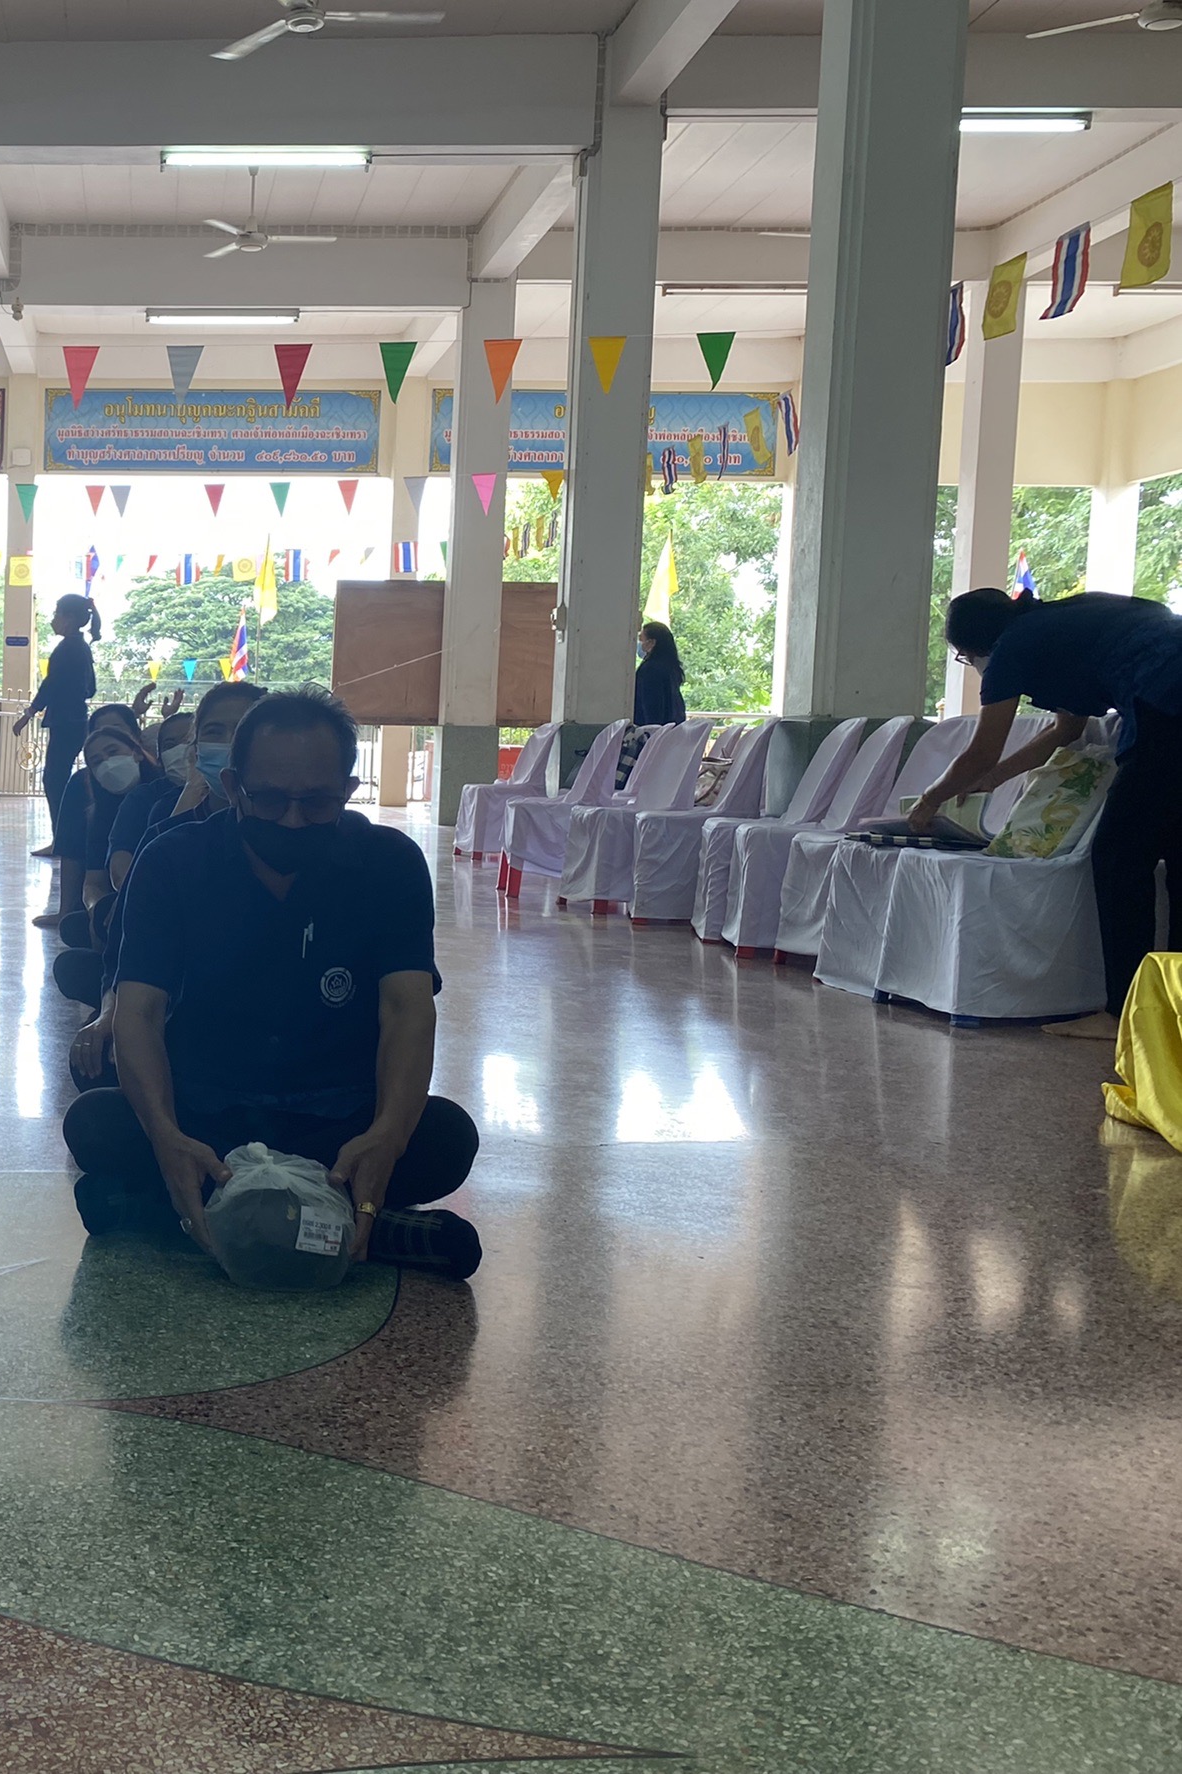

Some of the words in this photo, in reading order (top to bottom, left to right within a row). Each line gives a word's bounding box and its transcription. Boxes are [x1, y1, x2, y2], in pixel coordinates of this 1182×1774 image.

[104, 396, 321, 424] อนุโมทนาบุญคณะกฐินสามัคคี
[57, 424, 227, 442] มูลนิธิสว่างศรัทธาธรรมสถานฉะเชิงเทรา
[231, 425, 368, 440] ศาลเจ้าพ่อหลักเมืองฉะเชิงเทรา
[67, 444, 204, 465] ทำบุญสร้างศาลาการเปรียญ
[208, 445, 245, 462] จำนวน
[332, 451, 356, 463] บาท
